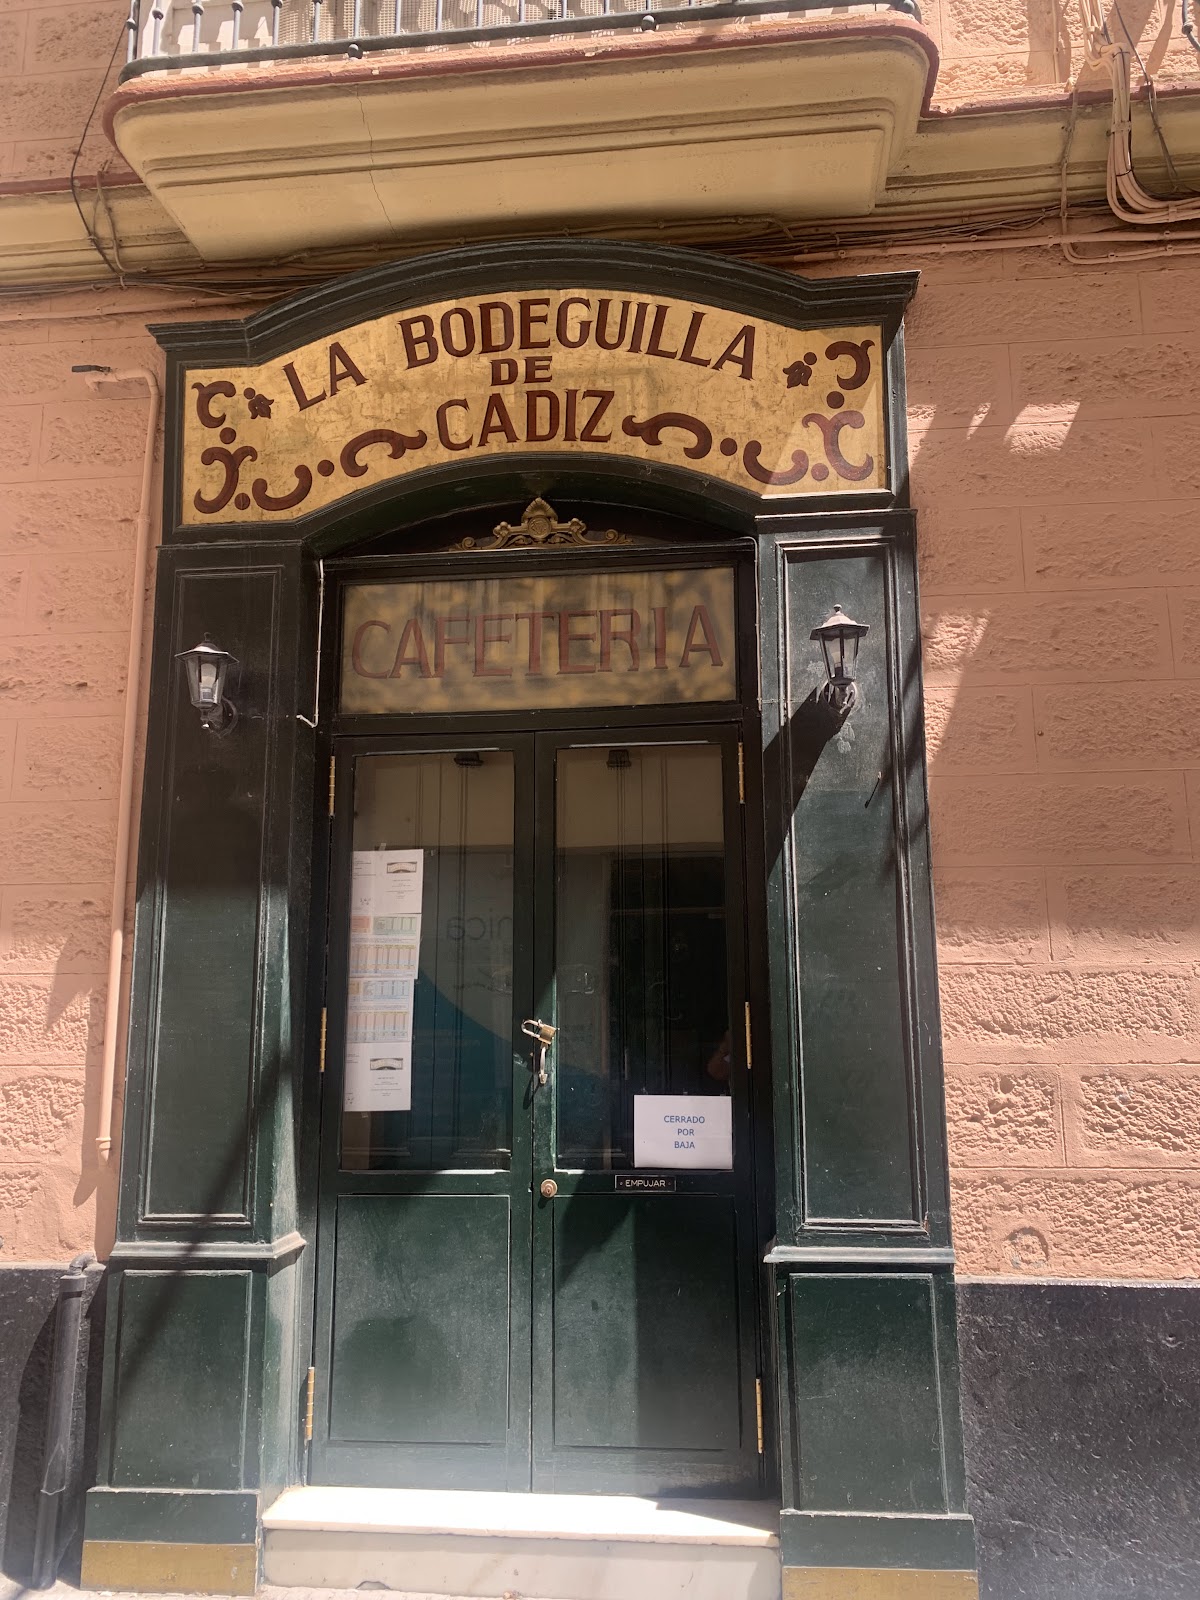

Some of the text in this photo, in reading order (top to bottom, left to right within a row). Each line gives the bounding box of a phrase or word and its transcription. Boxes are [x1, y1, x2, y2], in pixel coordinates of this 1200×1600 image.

[282, 297, 756, 412] LA BODEGUILLA
[490, 356, 553, 386] DE
[436, 388, 615, 451] CADIZ
[351, 604, 724, 679] CAFETERIA
[663, 1115, 706, 1124] CERRADO
[677, 1128, 695, 1136] POR
[674, 1140, 696, 1149] BAJA
[624, 1179, 666, 1188] EMPUJAR
